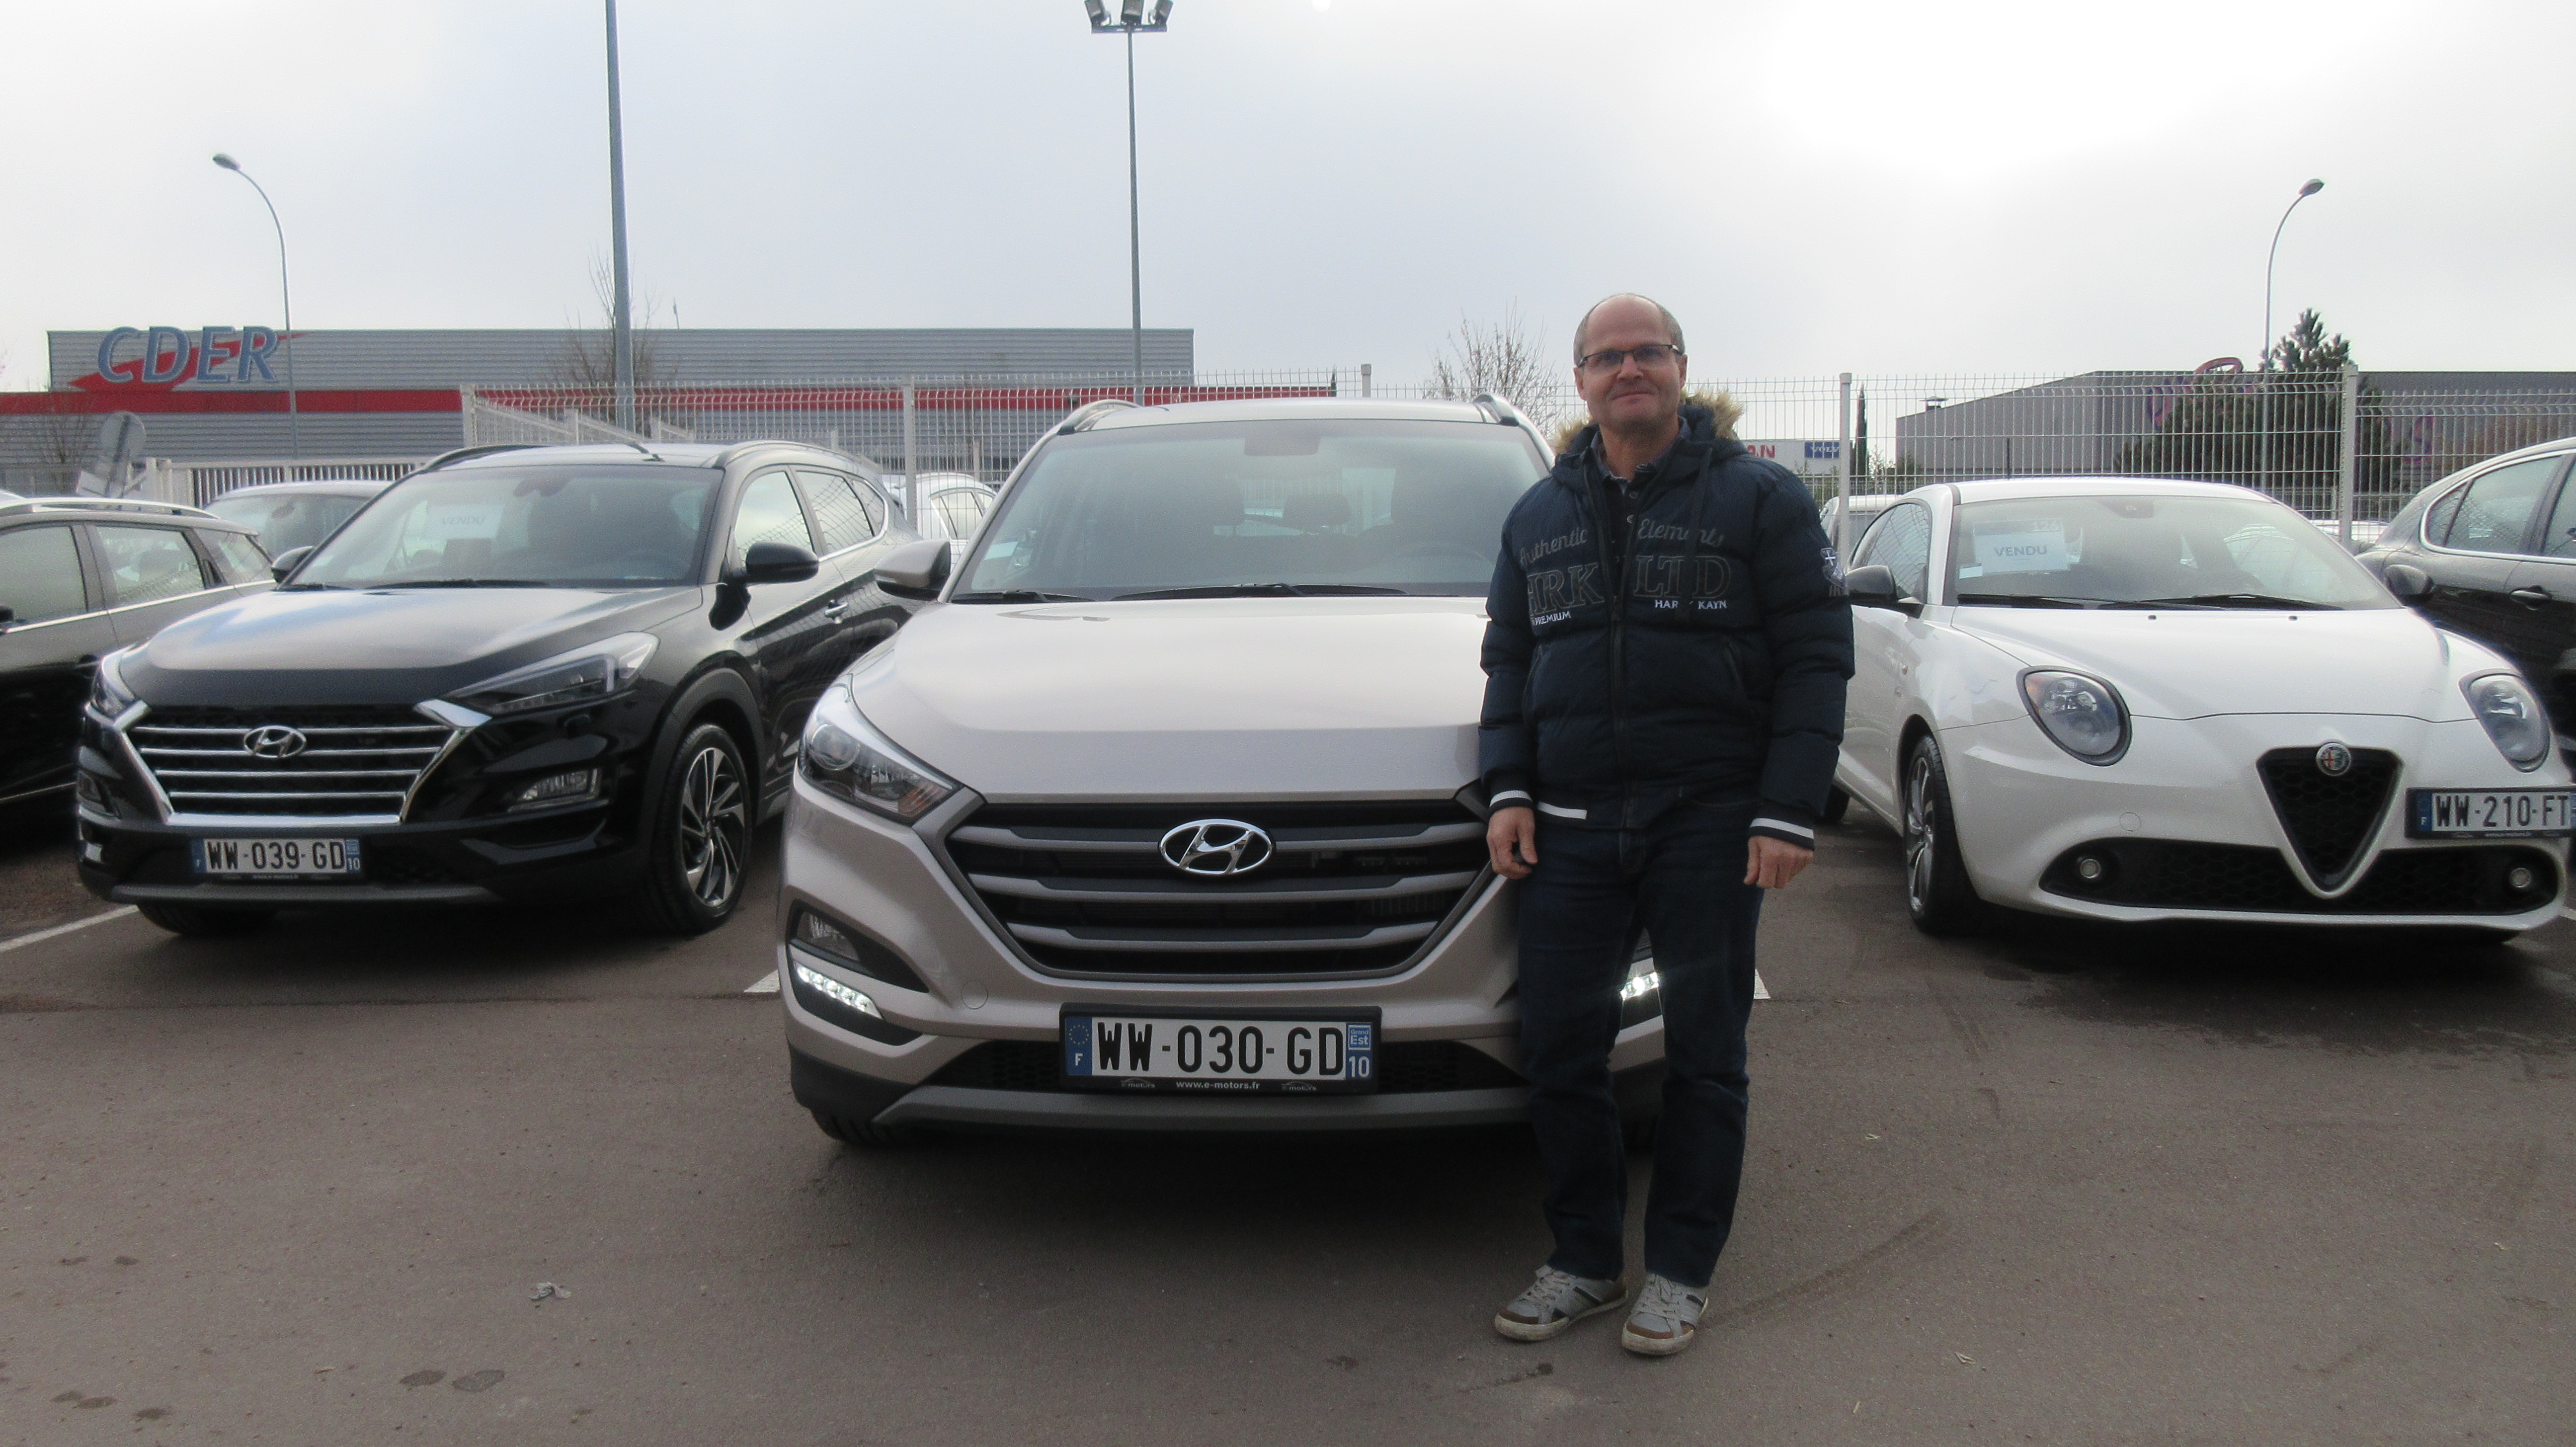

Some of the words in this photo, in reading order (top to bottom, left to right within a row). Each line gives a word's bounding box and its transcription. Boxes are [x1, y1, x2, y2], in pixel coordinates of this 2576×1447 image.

[98, 326, 278, 383] CDER
[1747, 444, 1775, 458] AN
[1520, 526, 1588, 568] Authentic
[1994, 545, 2048, 557] VENDU
[1632, 555, 1732, 599] LTD
[1697, 600, 1727, 610] KAYN
[2436, 795, 2569, 827] WW-210-FT
[207, 841, 345, 870] WW-039-GD
[1097, 1022, 1344, 1075] WW-030-GD
[1350, 1035, 1369, 1045] Est
[1075, 1053, 1083, 1066] F
[1349, 1056, 1370, 1078] 10
